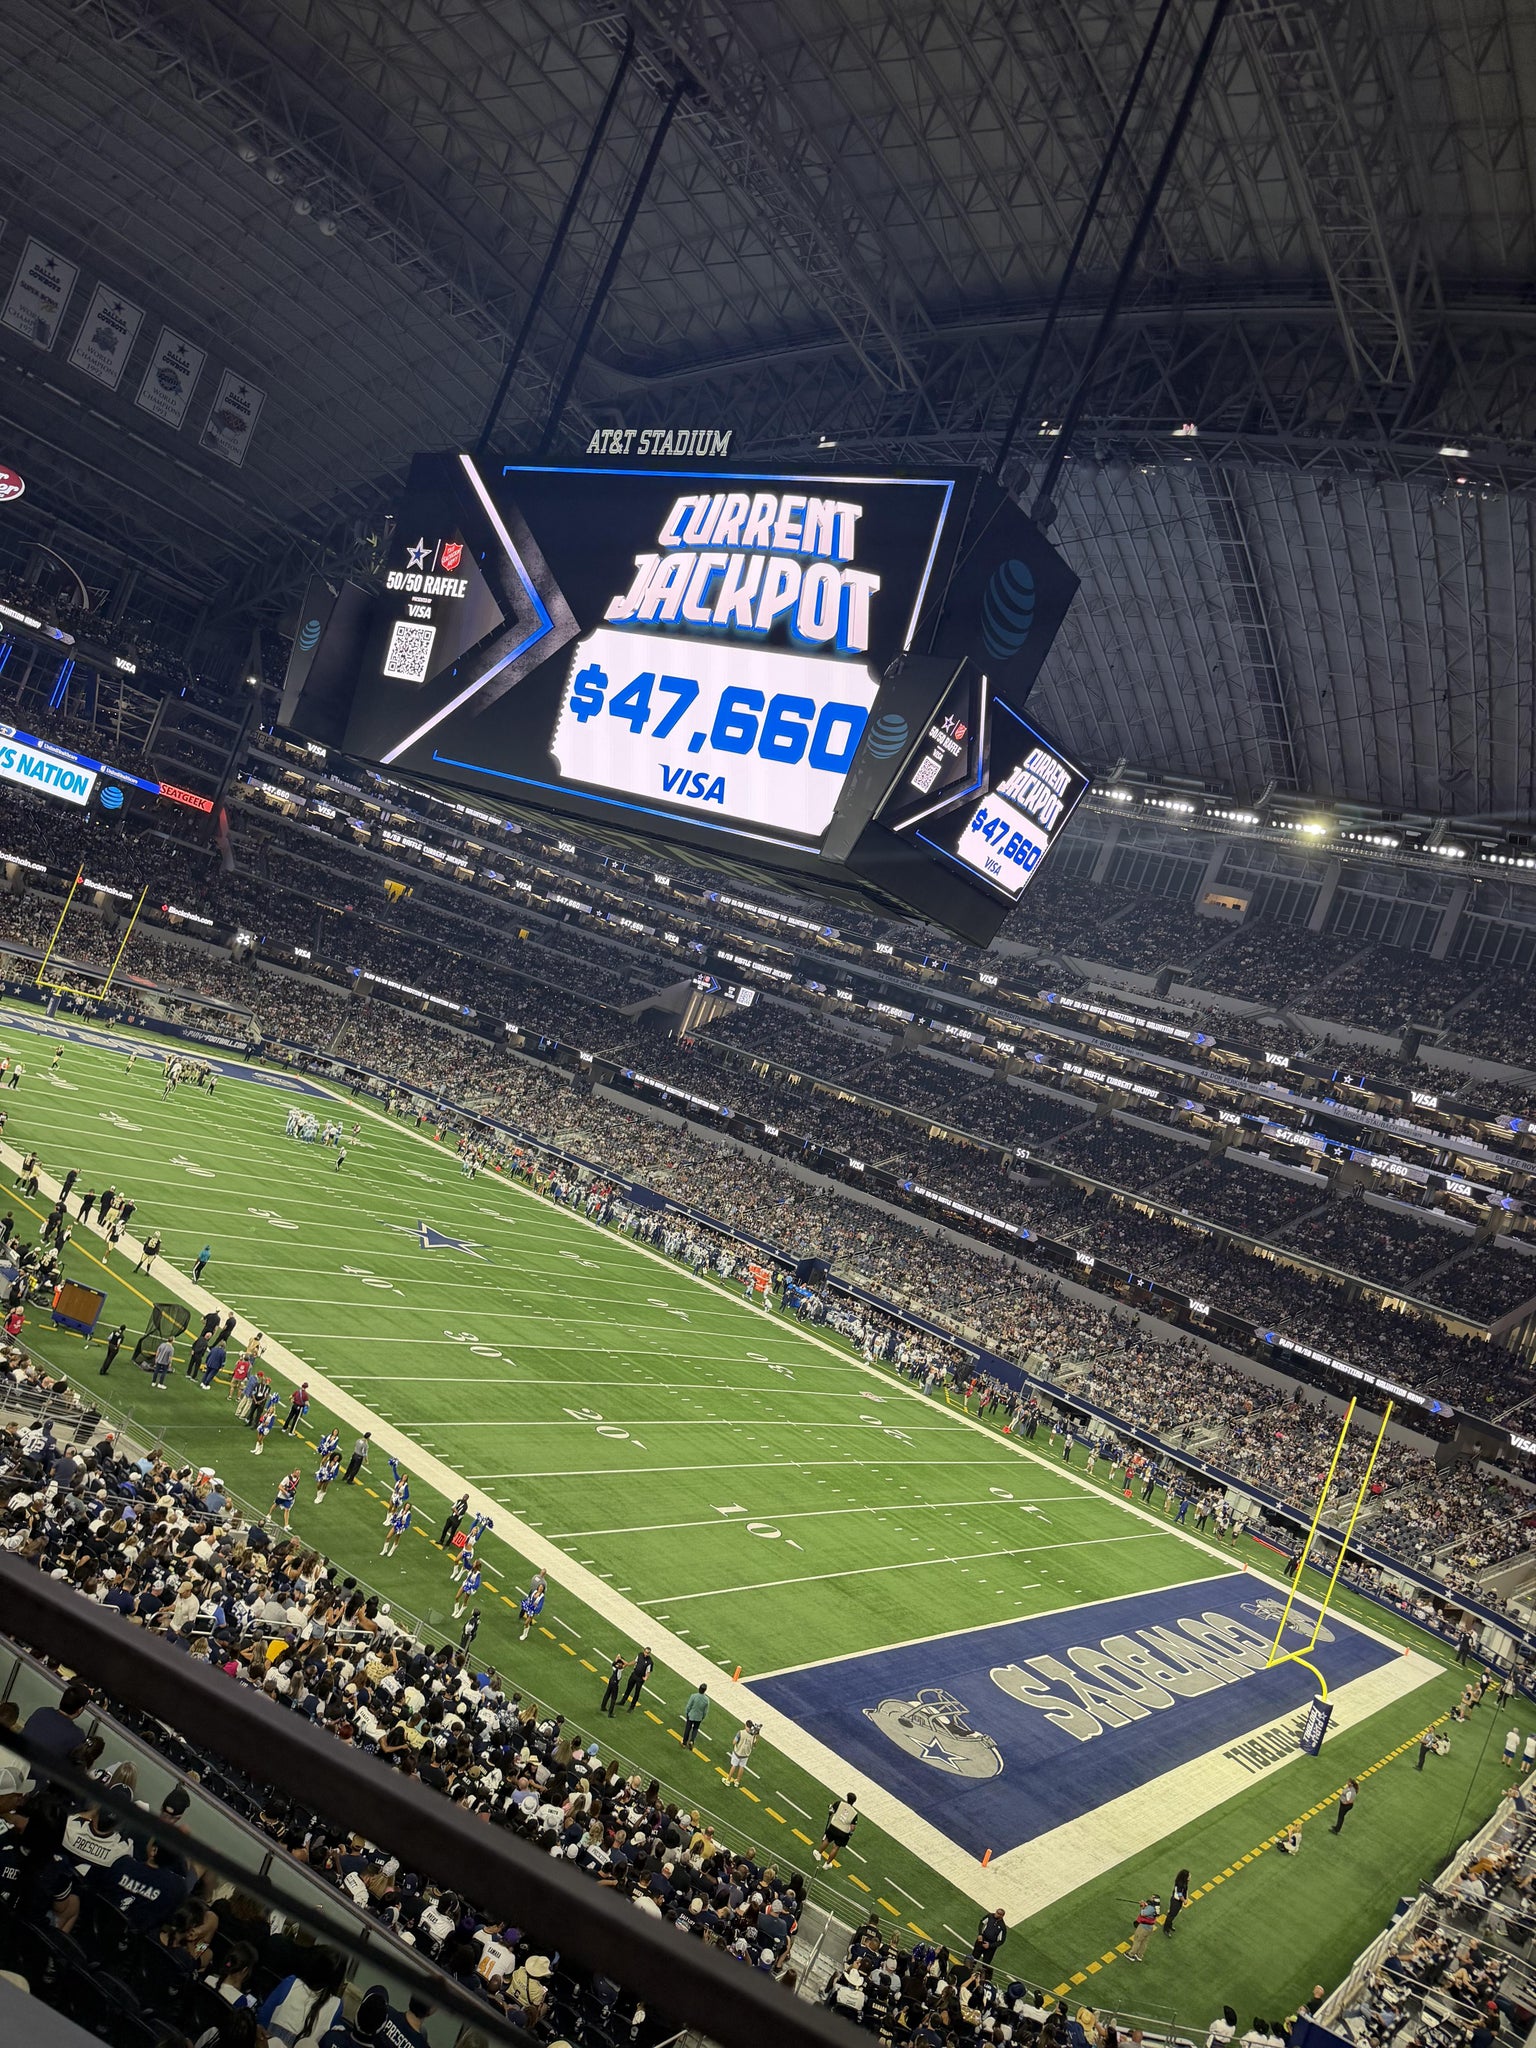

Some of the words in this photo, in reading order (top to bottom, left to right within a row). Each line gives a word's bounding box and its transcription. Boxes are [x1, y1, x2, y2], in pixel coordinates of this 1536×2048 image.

[87, 344, 113, 366] WORLD
[153, 387, 176, 407] WORLD
[586, 429, 638, 456] AT&T
[638, 429, 732, 457] STADIUM
[657, 490, 864, 562] CURRENT
[386, 571, 421, 593] 50/50
[423, 575, 468, 598] RAFFLE
[407, 604, 432, 619] VISA
[603, 553, 880, 653] JACKPOT
[115, 656, 136, 674] VISA
[569, 663, 868, 774] $47,660
[306, 742, 327, 758] VISA
[17, 754, 89, 796] NATION
[1023, 748, 1071, 798] CURRENT
[658, 763, 726, 805] VISA
[160, 784, 207, 810] SEATGEEK
[996, 765, 1064, 831] JACKPOT
[318, 804, 336, 819] VISA
[558, 841, 576, 854] VISA
[971, 808, 1042, 872] $47,660
[984, 856, 1002, 876] VISA
[515, 880, 532, 892] VISA
[654, 873, 670, 886] VISA
[83, 878, 133, 901] Blockchain.com
[168, 905, 214, 927] Blockchain.com
[664, 932, 680, 944] VISA
[294, 947, 311, 960] VISA
[876, 942, 893, 955] VISA
[980, 973, 998, 986] VISA
[836, 989, 853, 1001] VISA
[997, 1011, 1021, 1020] MEREDITH
[1060, 997, 1074, 1006] PLAY
[1089, 1005, 1107, 1015] RAFFLE
[1136, 1018, 1146, 1026] THE
[1146, 1021, 1174, 1034] SALVATION
[1174, 1029, 1191, 1039] ARMY
[505, 1022, 519, 1034] VISA
[945, 1025, 972, 1040] $47,660
[996, 1040, 1015, 1054] VISA
[580, 1051, 593, 1063] VISA
[1265, 1051, 1290, 1068] VISA
[1063, 1063, 1082, 1074] 50/50
[1083, 1069, 1105, 1081] RAFFLE
[1106, 1076, 1133, 1090] CURRENT
[1132, 1084, 1159, 1098] JACKPOT
[1224, 1078, 1247, 1088] PERKINS
[1411, 1091, 1439, 1108] VISA
[1218, 1111, 1241, 1125] VISA
[1343, 1112, 1364, 1121] ROGER
[1366, 1118, 1397, 1131] STAUBACH
[764, 1124, 779, 1137] VISA
[1275, 1129, 1311, 1147] $47,660
[849, 1158, 865, 1171] VISA
[1370, 1158, 1407, 1177] $47,660
[1522, 1163, 1536, 1171] ROY
[1445, 1179, 1472, 1197] VISA
[247, 1207, 300, 1230] 50
[1075, 1251, 1095, 1267] VISA
[1188, 1299, 1210, 1315] VISA
[444, 1330, 503, 1358] 30
[1279, 1336, 1294, 1349] PLAY
[1294, 1343, 1312, 1357] 50/50
[1312, 1351, 1331, 1365] RAFFLE
[1331, 1358, 1364, 1379] BENEFITING
[1364, 1374, 1375, 1383] THE
[1376, 1378, 1407, 1397] SALVATION
[1407, 1392, 1425, 1404] ARMY
[562, 1408, 630, 1439] 20
[1510, 1433, 1536, 1455] VISA
[709, 1502, 782, 1539] 10
[990, 1611, 1289, 1741] COWBOYS
[73, 1837, 111, 1860] PRESCOTT
[118, 1874, 161, 1902] DALLAS
[479, 1956, 496, 1978] 41
